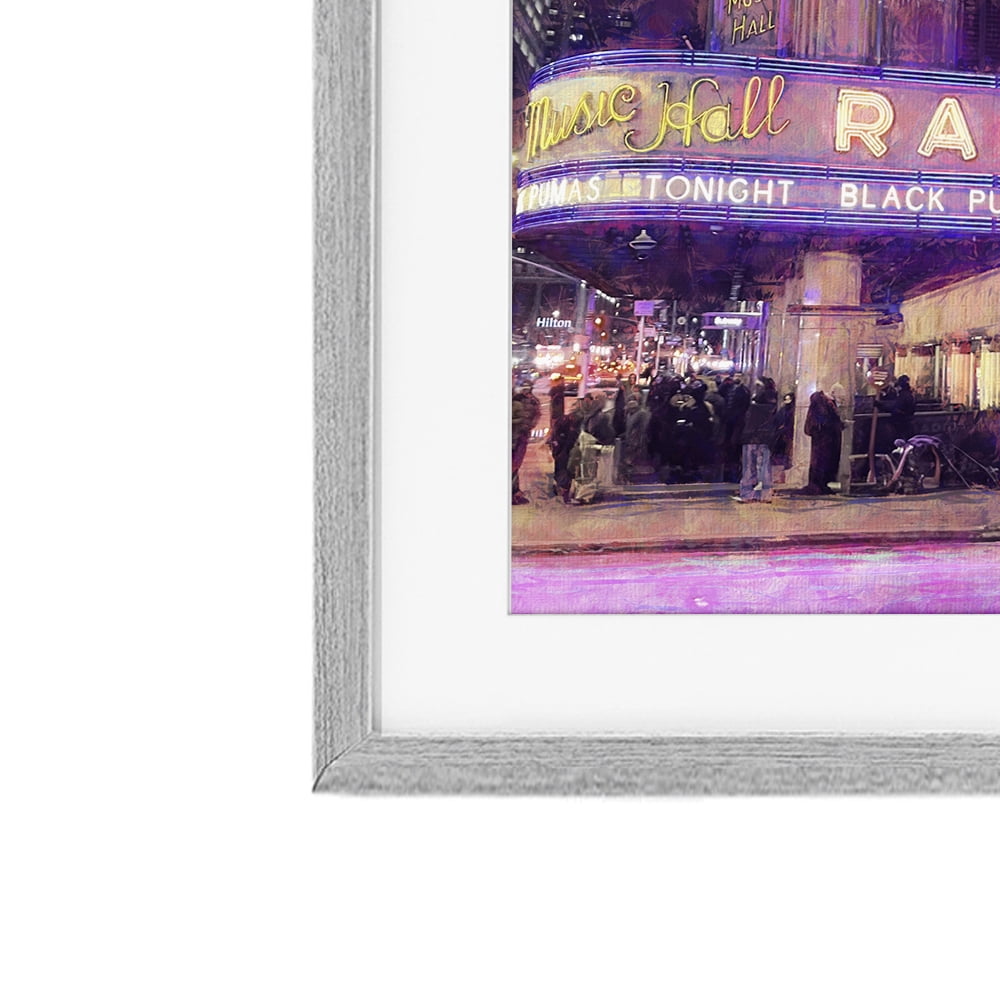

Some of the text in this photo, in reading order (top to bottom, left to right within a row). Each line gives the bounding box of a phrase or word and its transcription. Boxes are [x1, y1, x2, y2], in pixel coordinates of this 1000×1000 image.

[525, 74, 791, 163] Music Hall
[527, 174, 601, 208] PUMAS
[645, 174, 795, 206] TONIGHT
[839, 182, 945, 212] BLACK
[536, 317, 572, 328] Hilton
